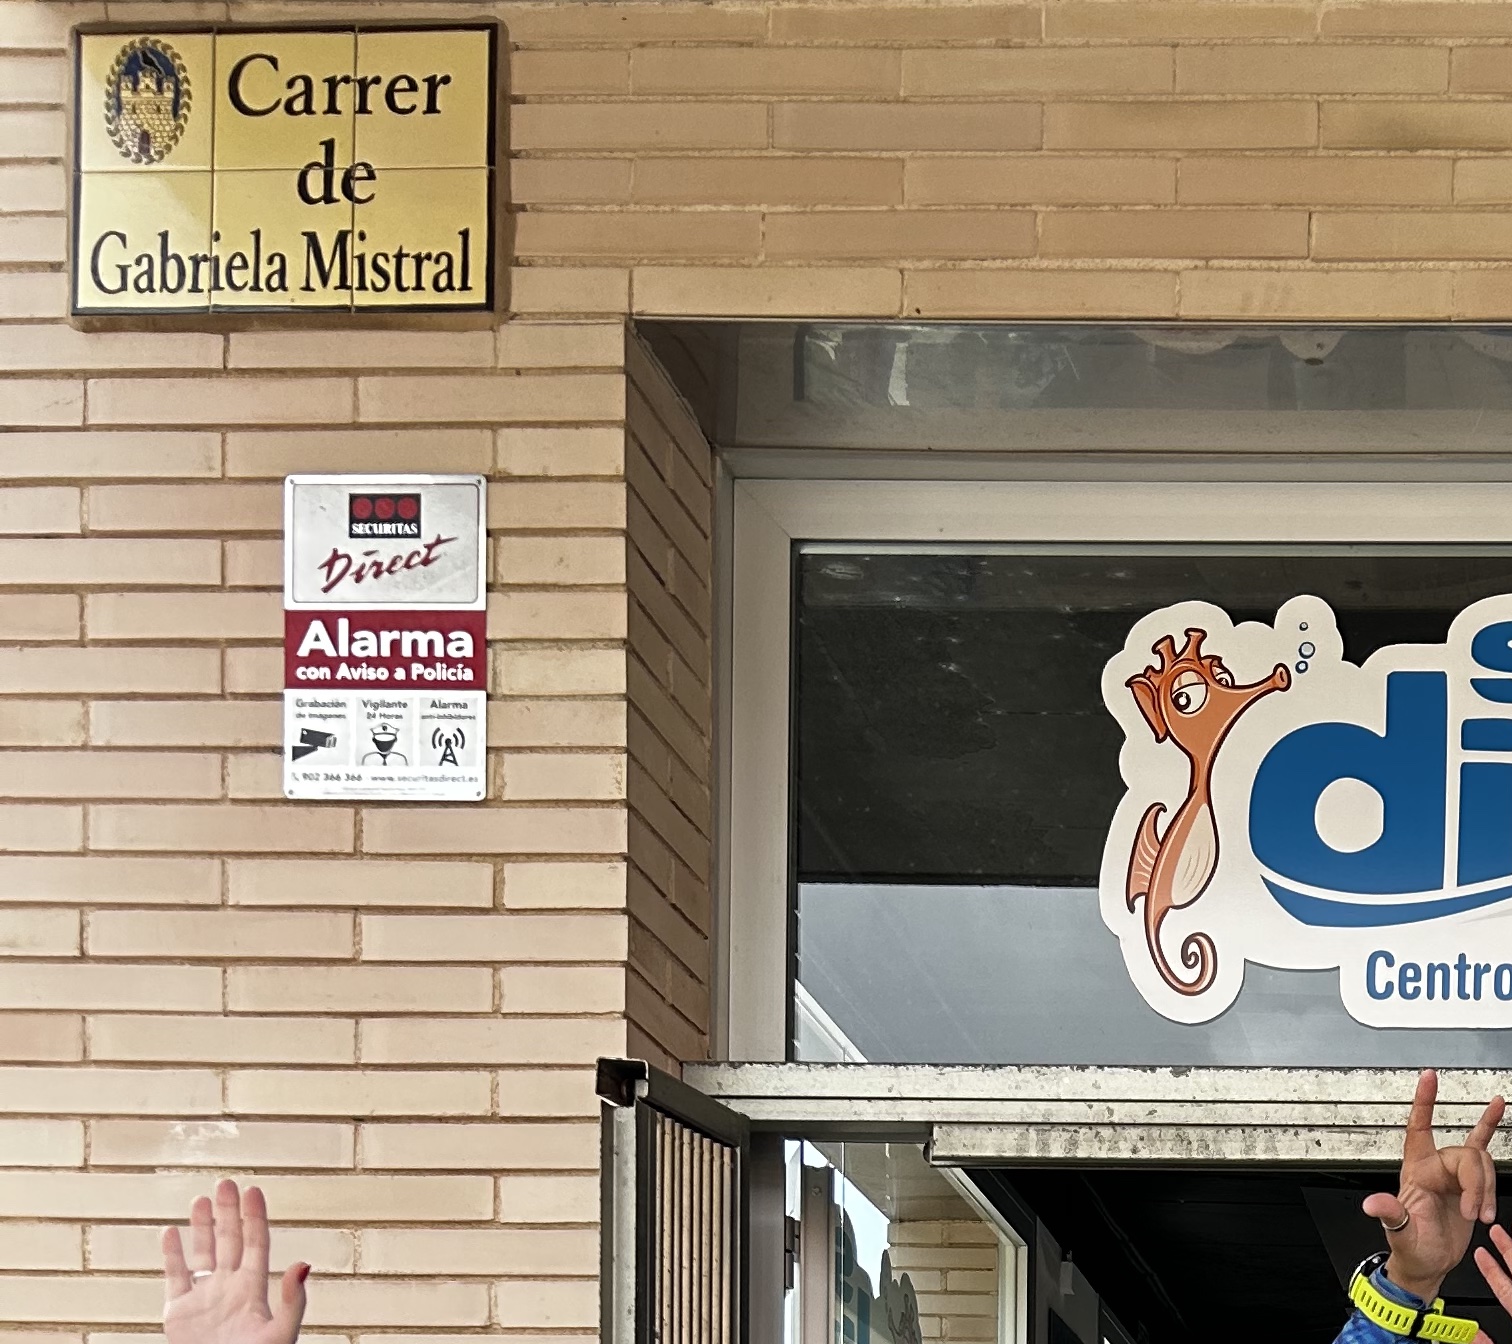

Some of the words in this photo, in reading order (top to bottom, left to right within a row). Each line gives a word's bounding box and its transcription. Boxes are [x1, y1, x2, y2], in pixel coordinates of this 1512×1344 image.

[228, 53, 451, 117] Carrer
[297, 138, 377, 205] de
[90, 227, 288, 295] Gabriela
[300, 227, 472, 293] Mistral
[352, 523, 418, 535] SECURITAS
[317, 534, 458, 594] Direct
[297, 618, 474, 658] Alarma
[296, 666, 331, 681] con
[335, 662, 389, 681] Aviso
[393, 666, 406, 681] a
[411, 662, 474, 681] Policía
[361, 699, 408, 711] Vigilante
[430, 699, 468, 709] Alarma
[302, 773, 320, 782] 902
[323, 773, 341, 782] 366
[344, 773, 363, 782] 366
